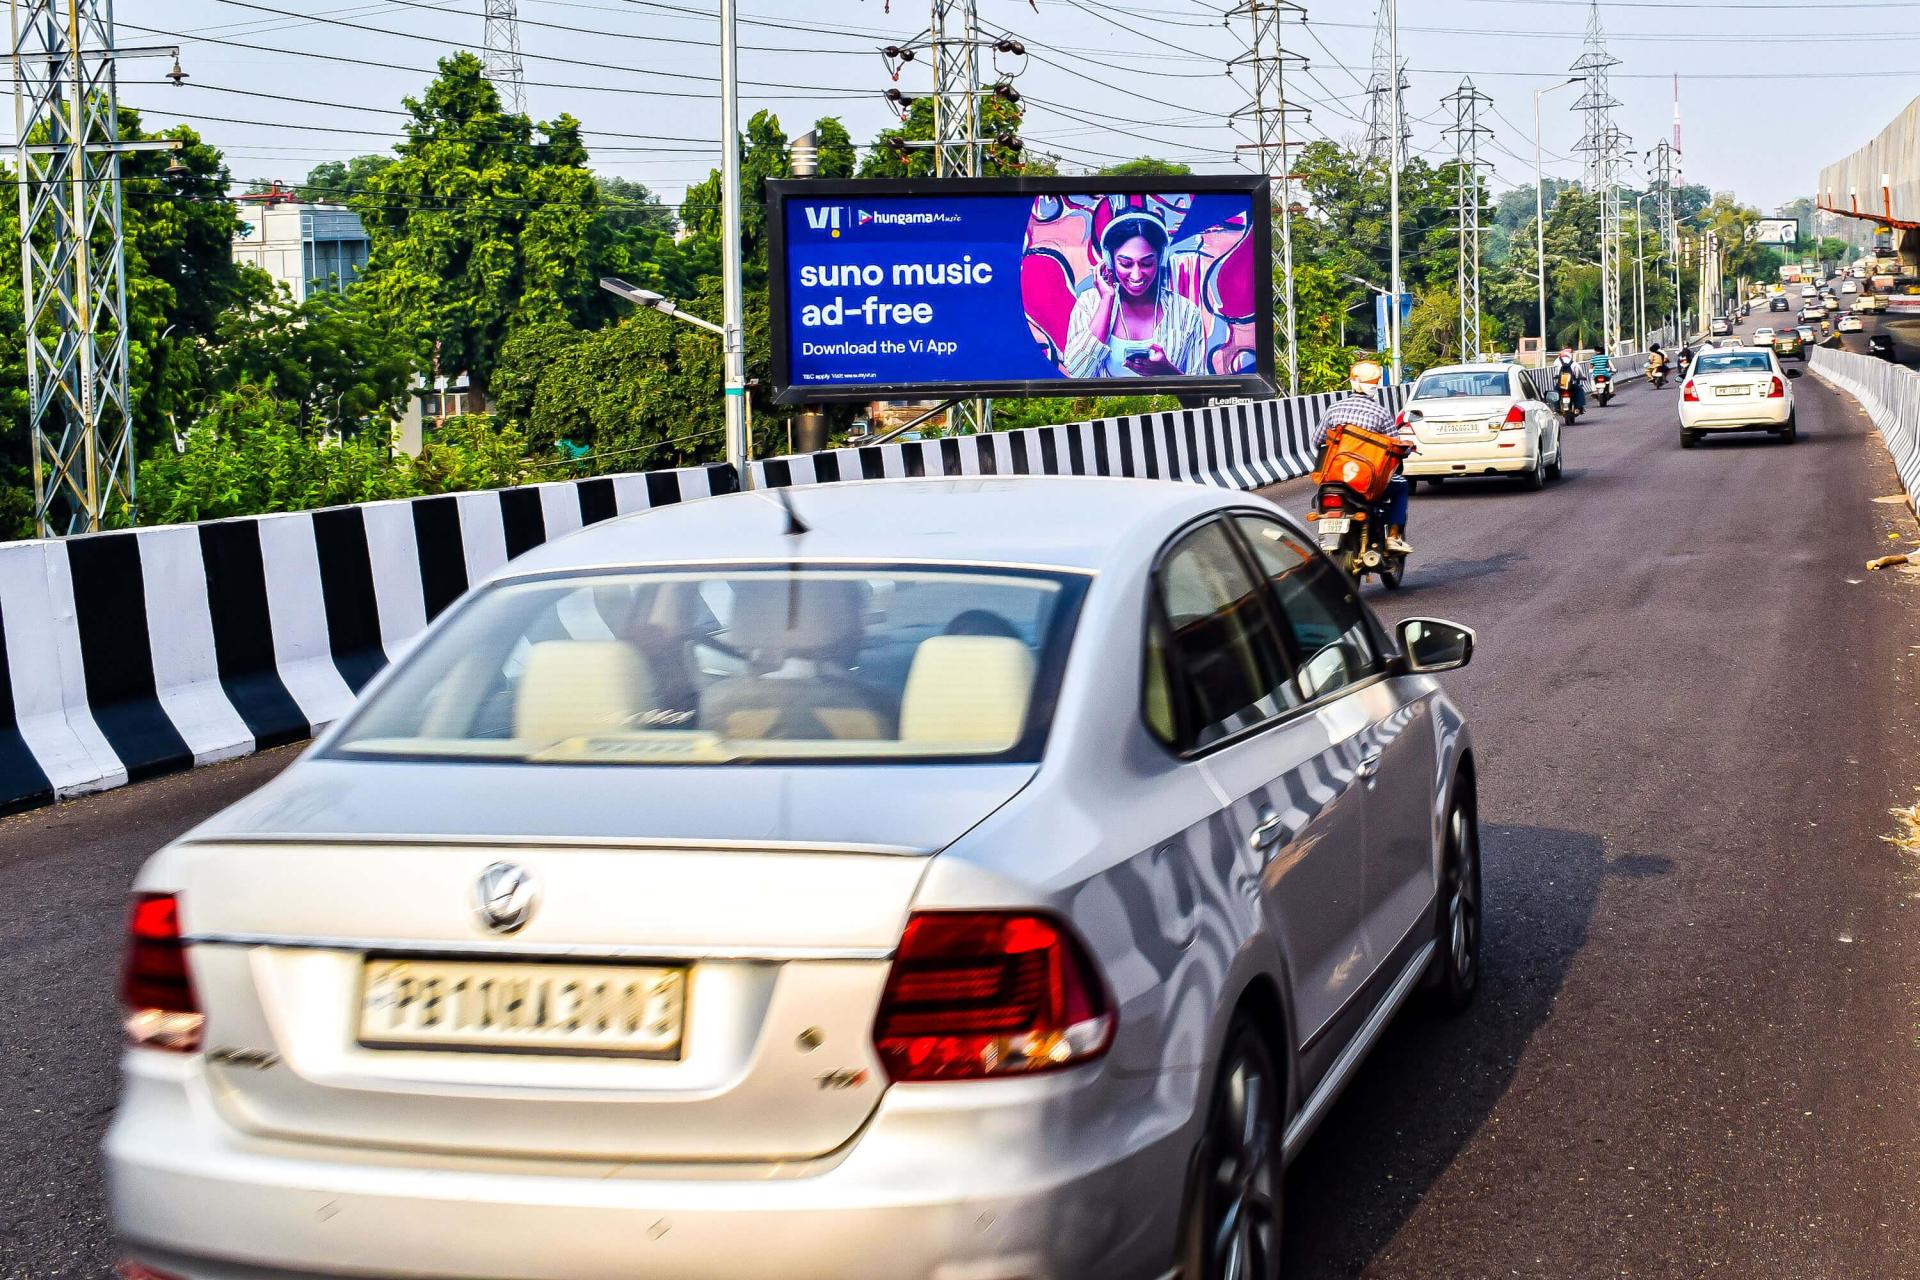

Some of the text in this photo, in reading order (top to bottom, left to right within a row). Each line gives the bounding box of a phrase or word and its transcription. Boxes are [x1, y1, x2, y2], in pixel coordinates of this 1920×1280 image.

[800, 255, 993, 287] suno music
[801, 296, 933, 326] ad-free
[802, 339, 958, 356] Download the Vi App
